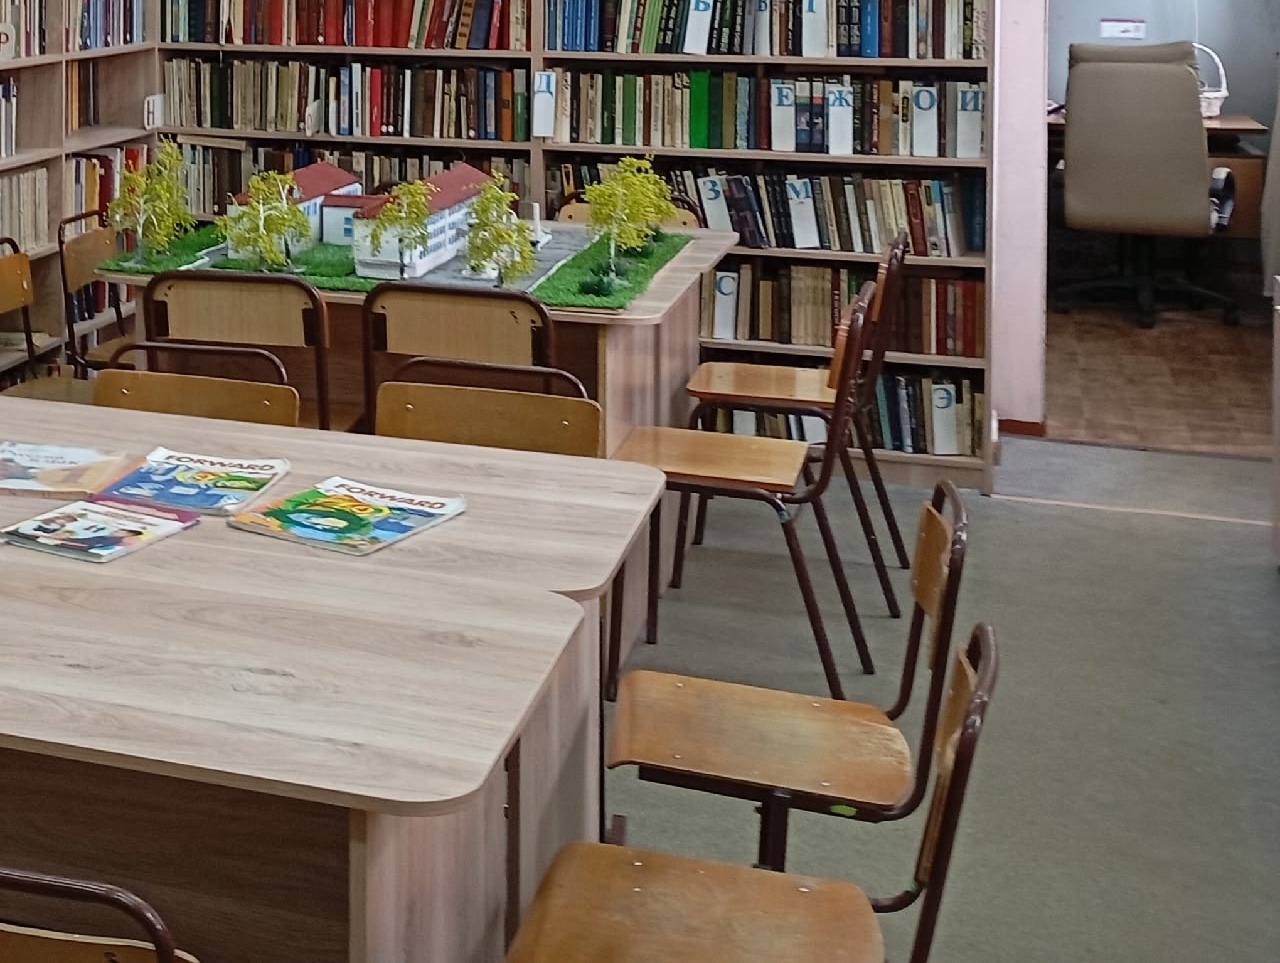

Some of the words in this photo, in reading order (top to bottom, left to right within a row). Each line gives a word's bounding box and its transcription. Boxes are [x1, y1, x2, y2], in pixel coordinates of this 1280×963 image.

[776, 87, 794, 107] Е
[828, 90, 853, 107] Ж
[914, 89, 937, 111] О
[960, 91, 982, 111] И
[147, 99, 154, 126] Н
[703, 180, 721, 201] З
[787, 178, 812, 199] М
[716, 275, 735, 296] С
[935, 388, 952, 409] Э
[165, 455, 275, 471] FORWARD
[335, 483, 446, 509] FORWARD
